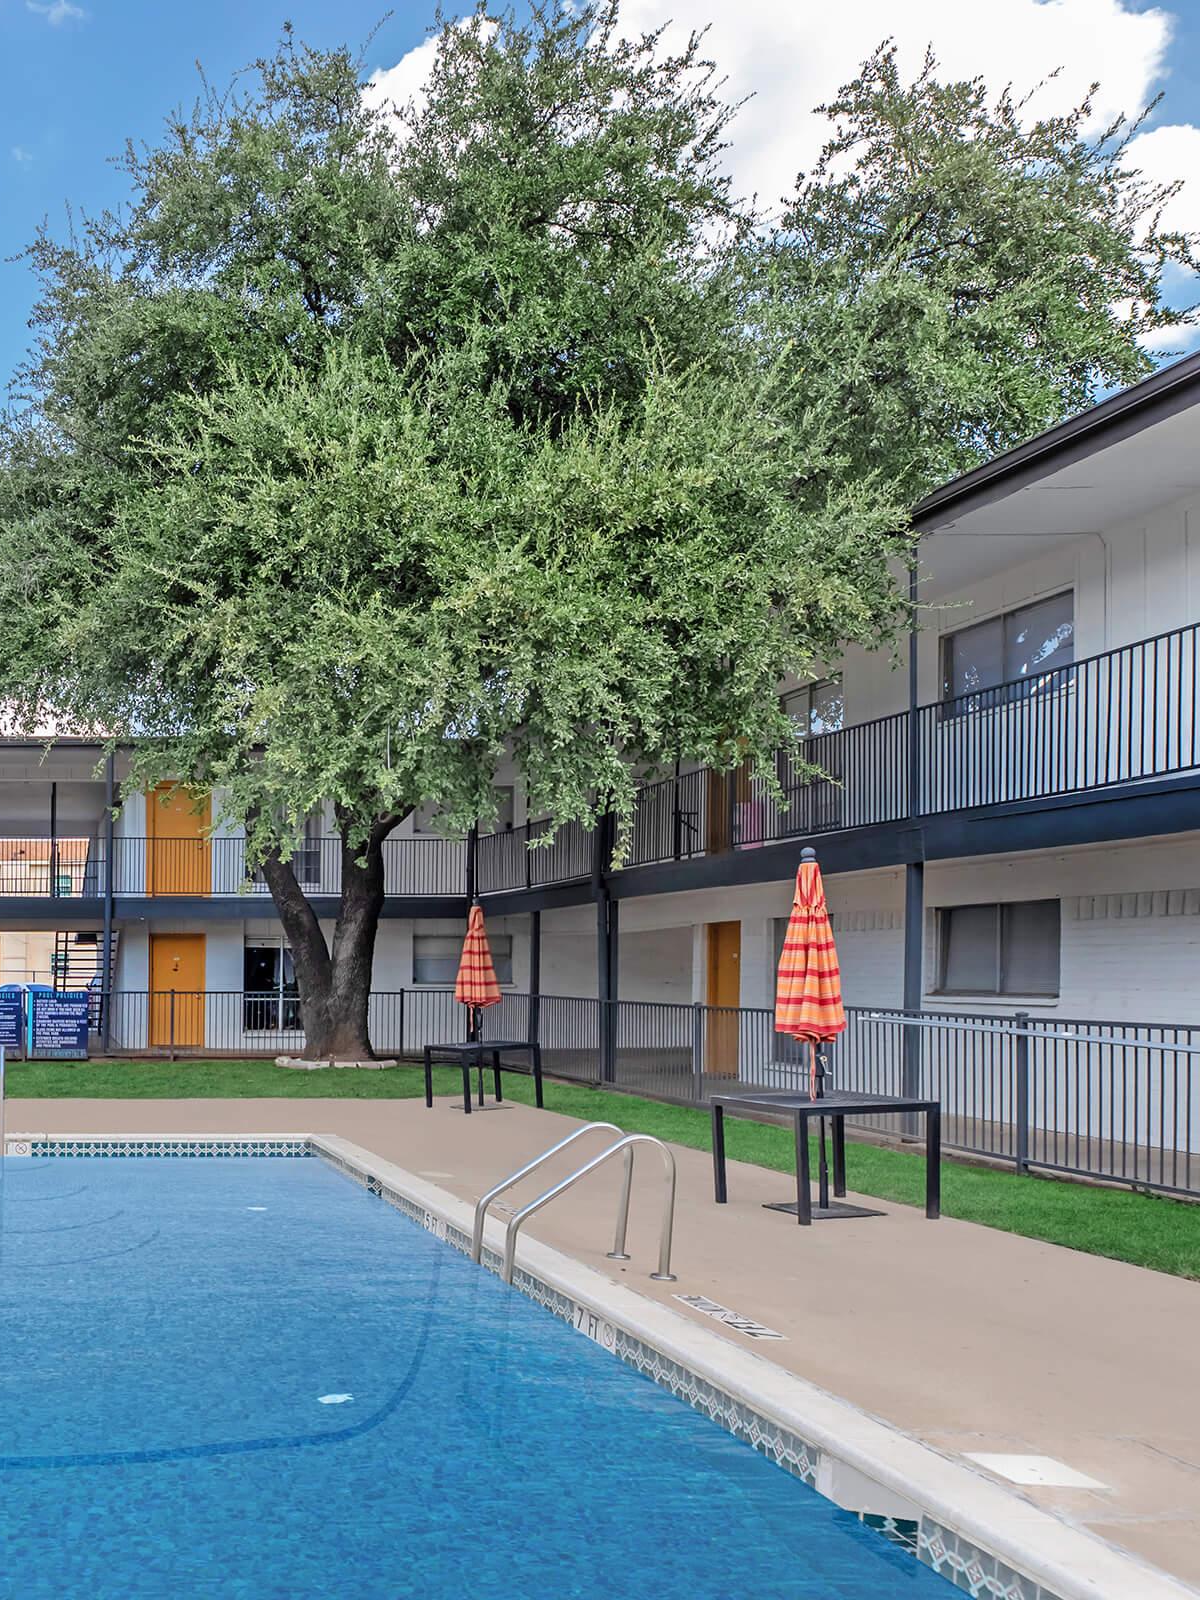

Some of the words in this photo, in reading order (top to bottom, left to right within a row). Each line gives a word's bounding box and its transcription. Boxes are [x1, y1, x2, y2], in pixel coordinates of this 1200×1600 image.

[426, 1213, 430, 1229] 5
[576, 1307, 584, 1329] 7
[588, 1314, 600, 1341] FT
